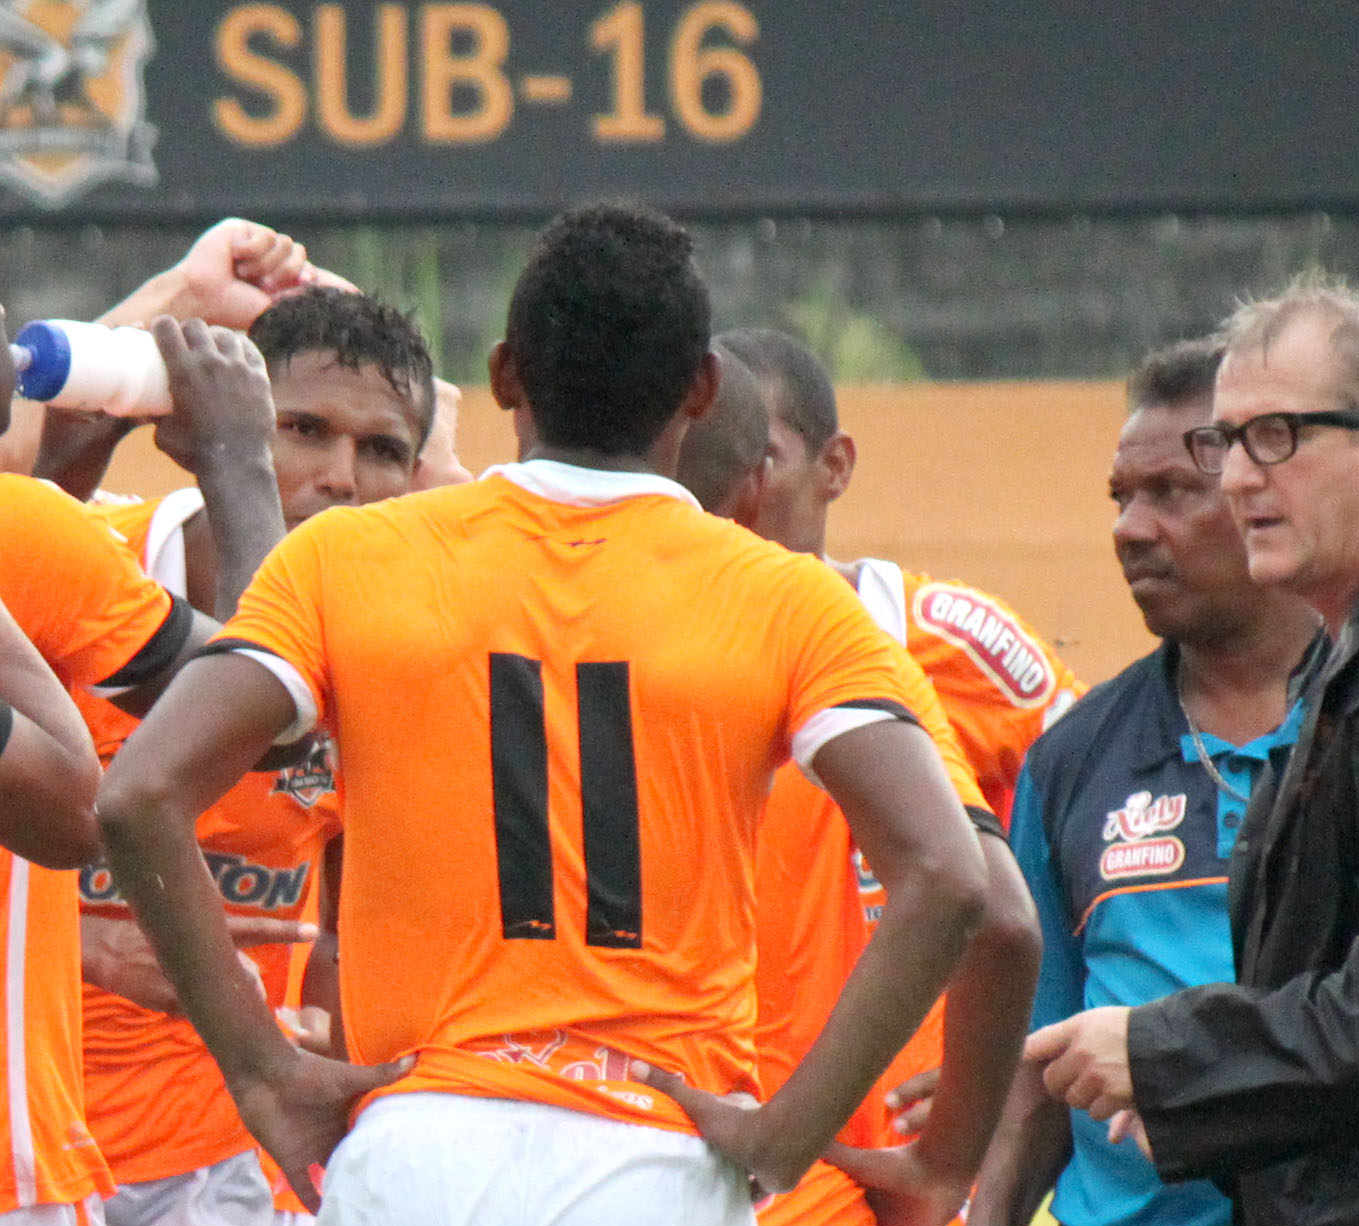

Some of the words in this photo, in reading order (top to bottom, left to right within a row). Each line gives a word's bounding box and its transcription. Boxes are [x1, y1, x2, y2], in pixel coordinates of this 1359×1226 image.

[213, 2, 764, 148] SUB-16
[930, 592, 1044, 694] GRANFINO
[489, 652, 642, 949] 11
[1106, 842, 1176, 873] GRANFINO
